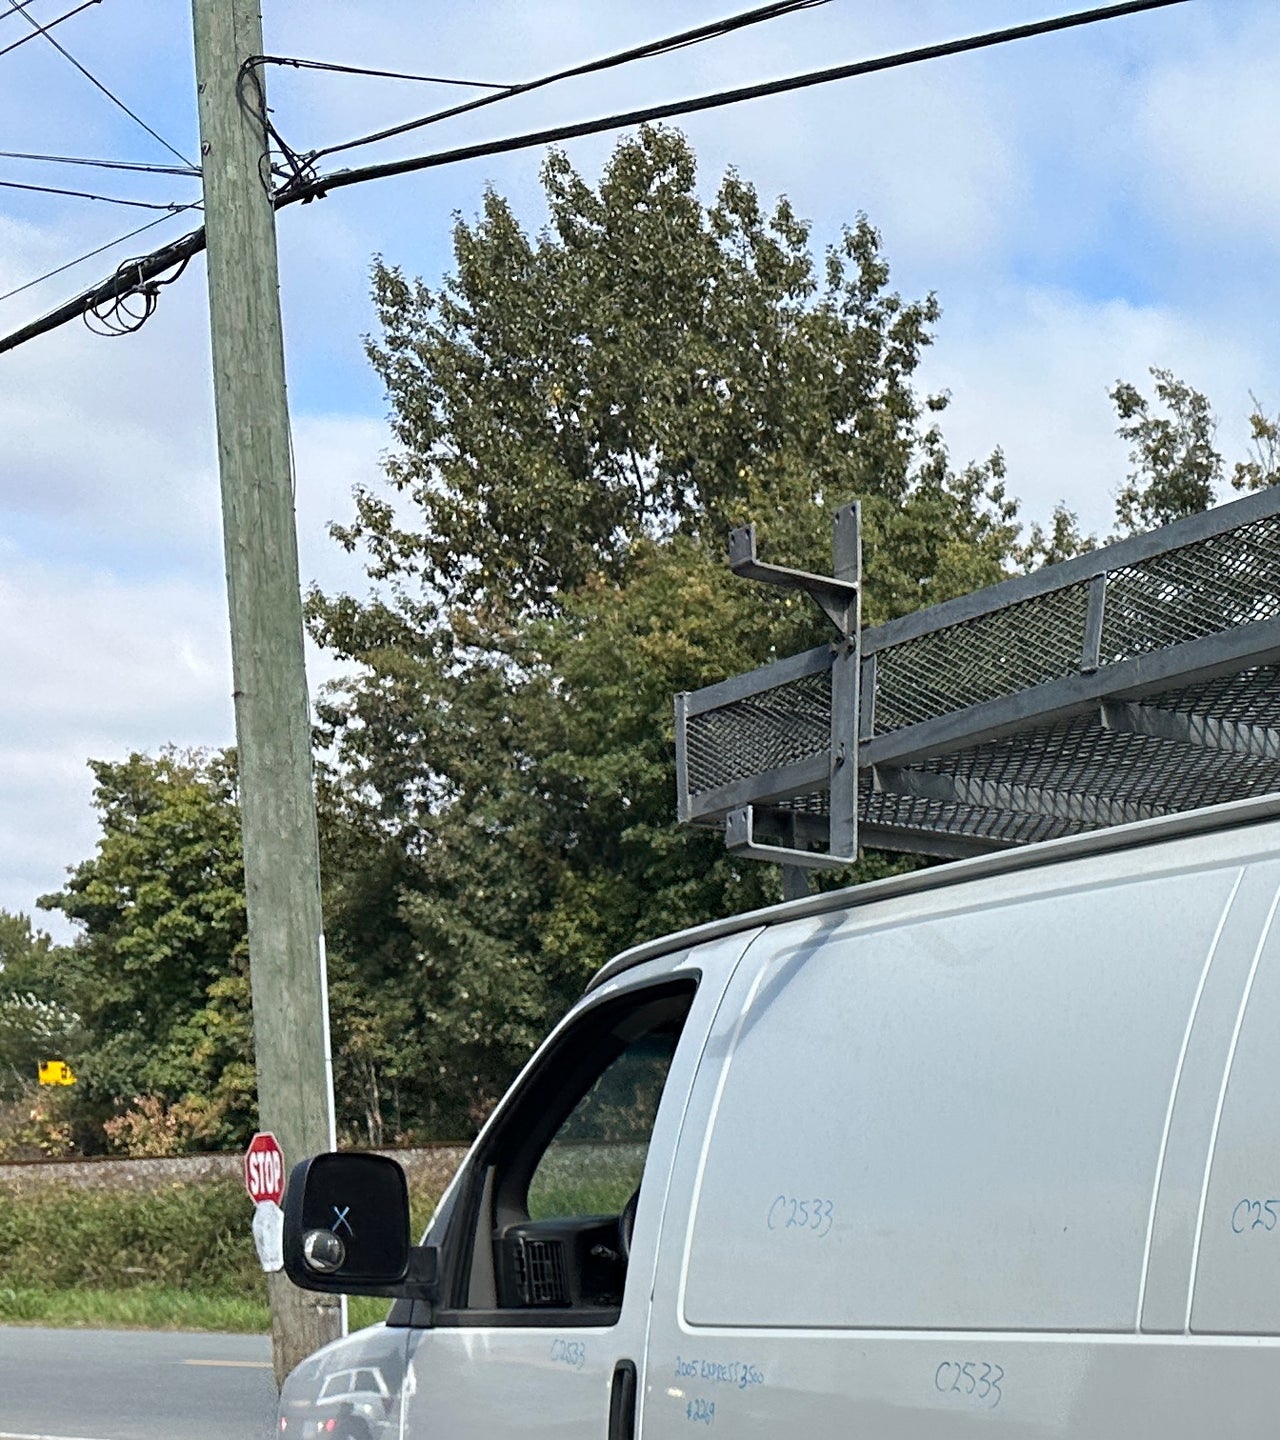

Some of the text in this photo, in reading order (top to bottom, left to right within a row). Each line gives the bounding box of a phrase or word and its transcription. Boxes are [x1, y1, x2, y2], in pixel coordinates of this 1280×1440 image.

[249, 1150, 281, 1196] STOP
[767, 1195, 834, 1238] C2533
[935, 1361, 1005, 1409] C2533
